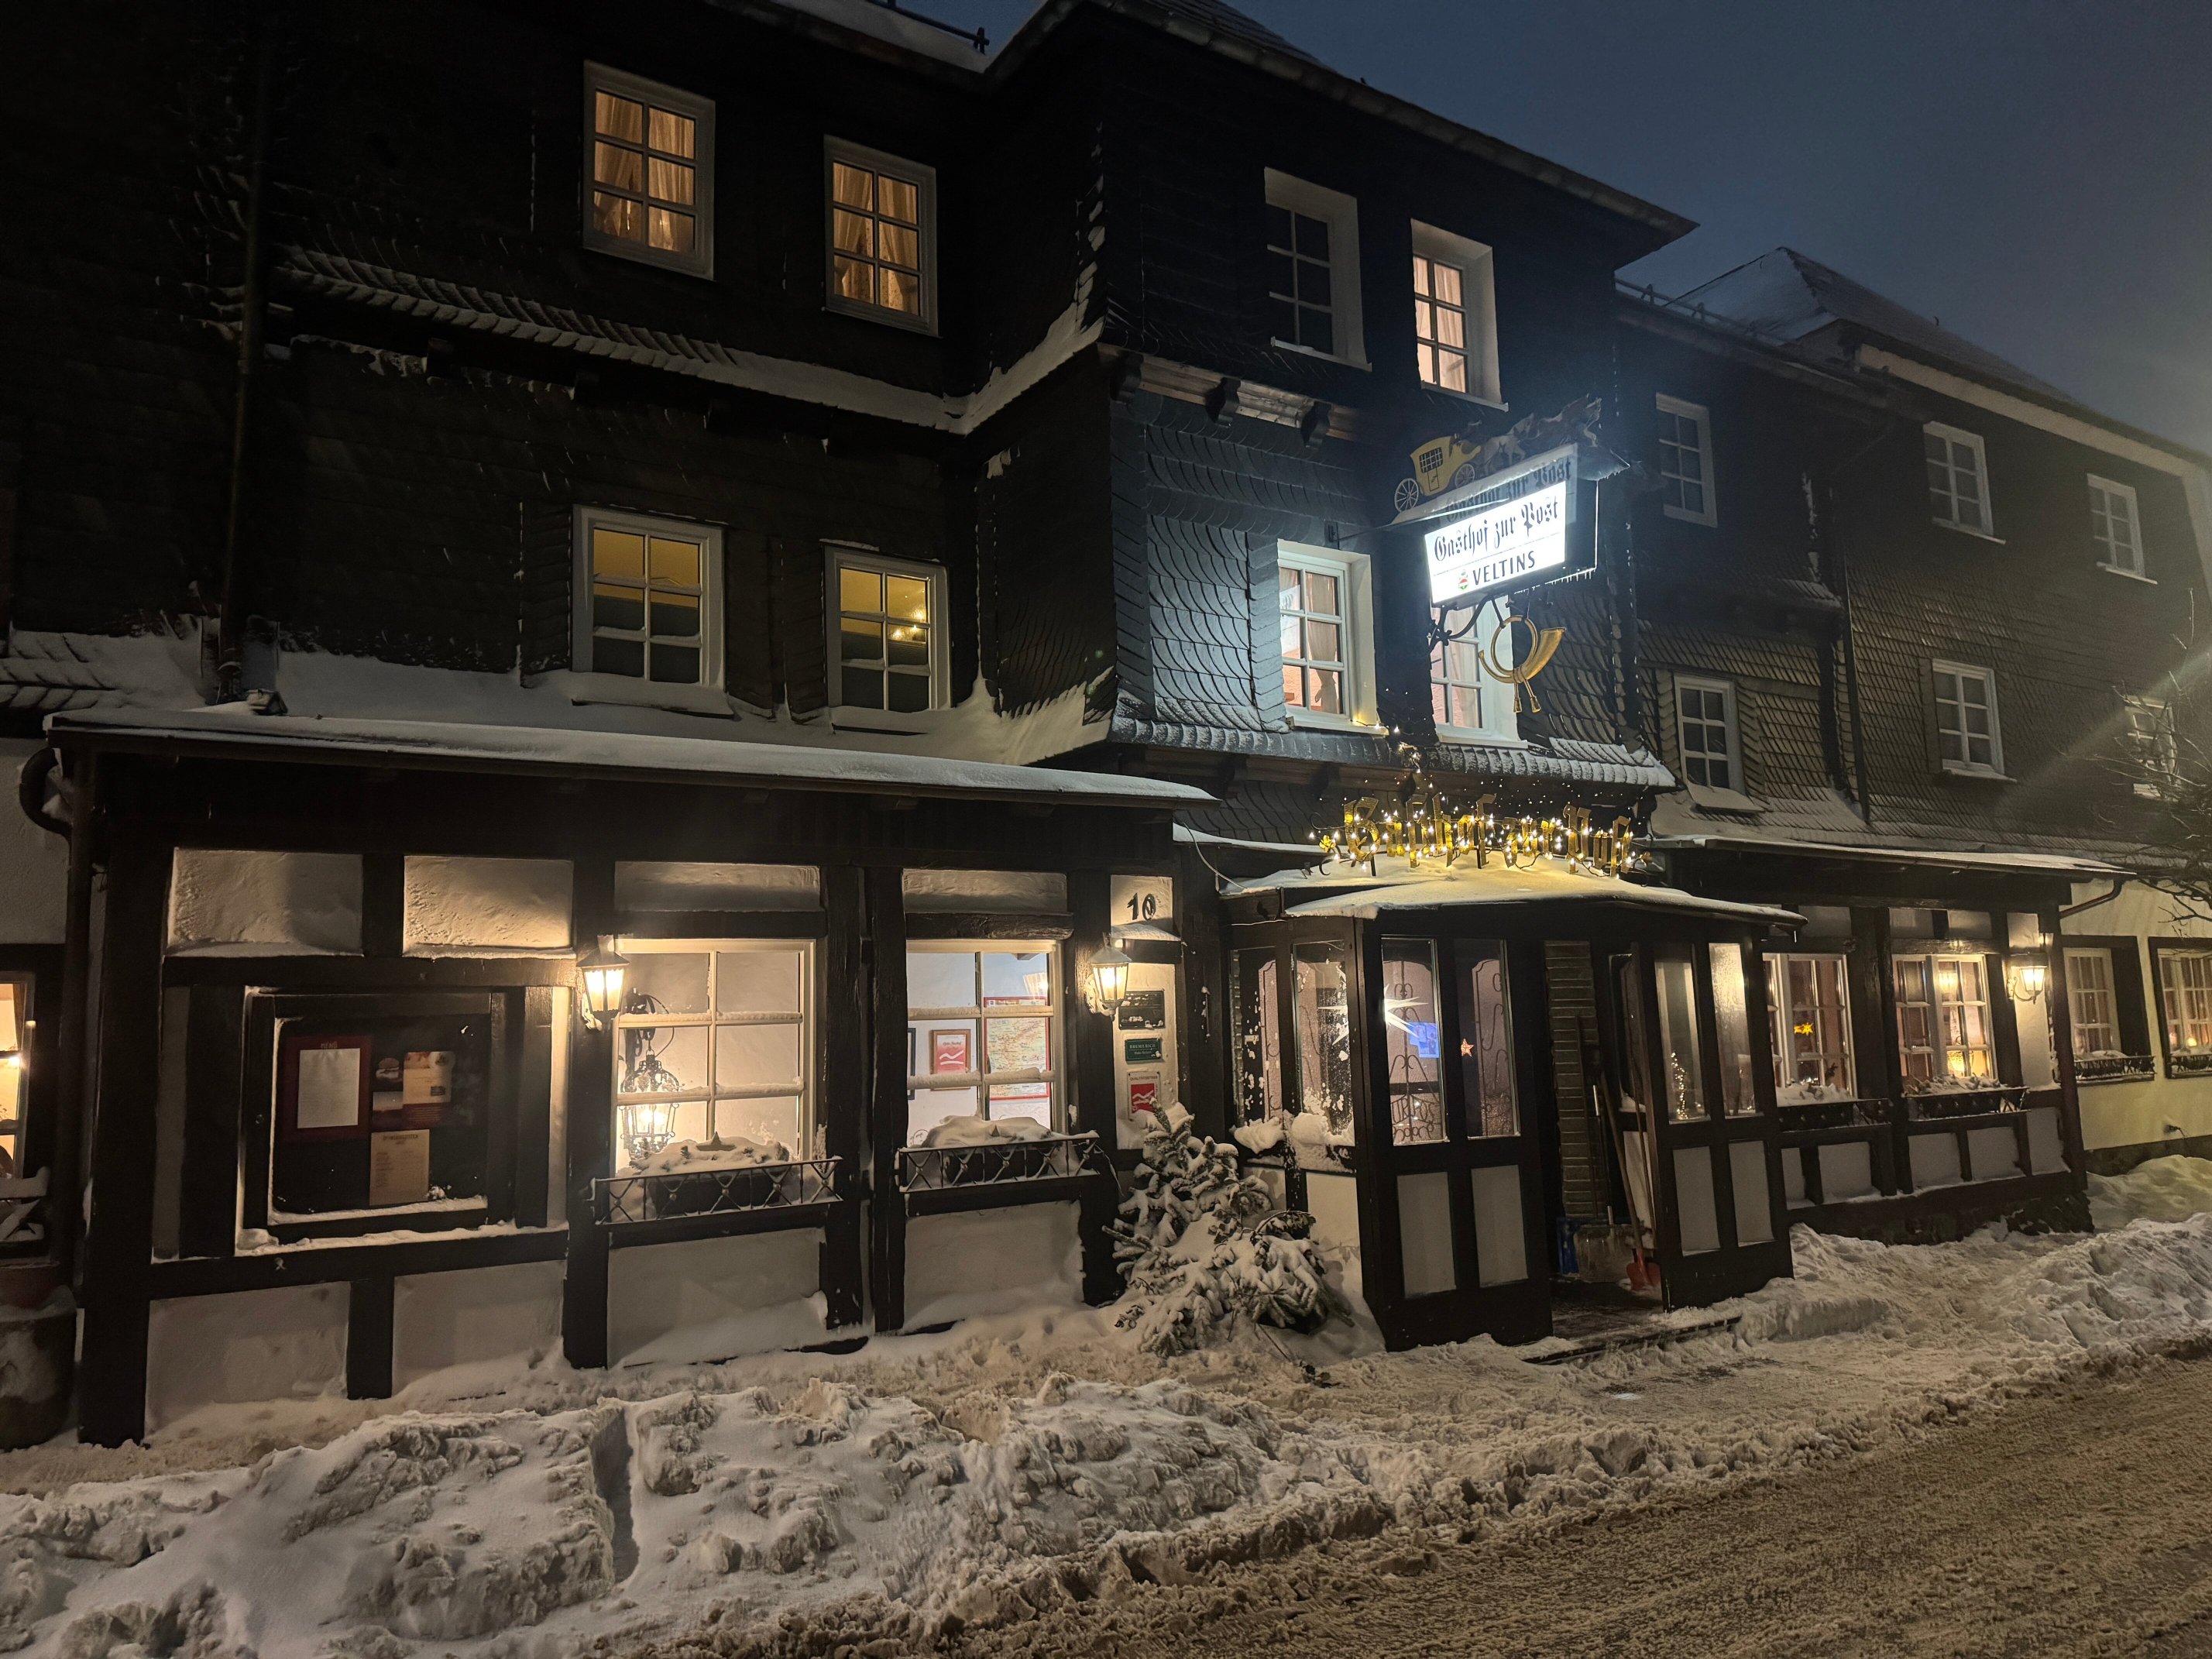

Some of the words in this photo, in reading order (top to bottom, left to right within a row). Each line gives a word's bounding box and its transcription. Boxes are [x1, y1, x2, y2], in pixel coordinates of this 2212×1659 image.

[1434, 519, 1489, 562] Gasthof
[1494, 515, 1516, 549] zur
[1520, 496, 1559, 538] Post
[1472, 550, 1536, 586] VELTINS
[1126, 892, 1157, 921] 10
